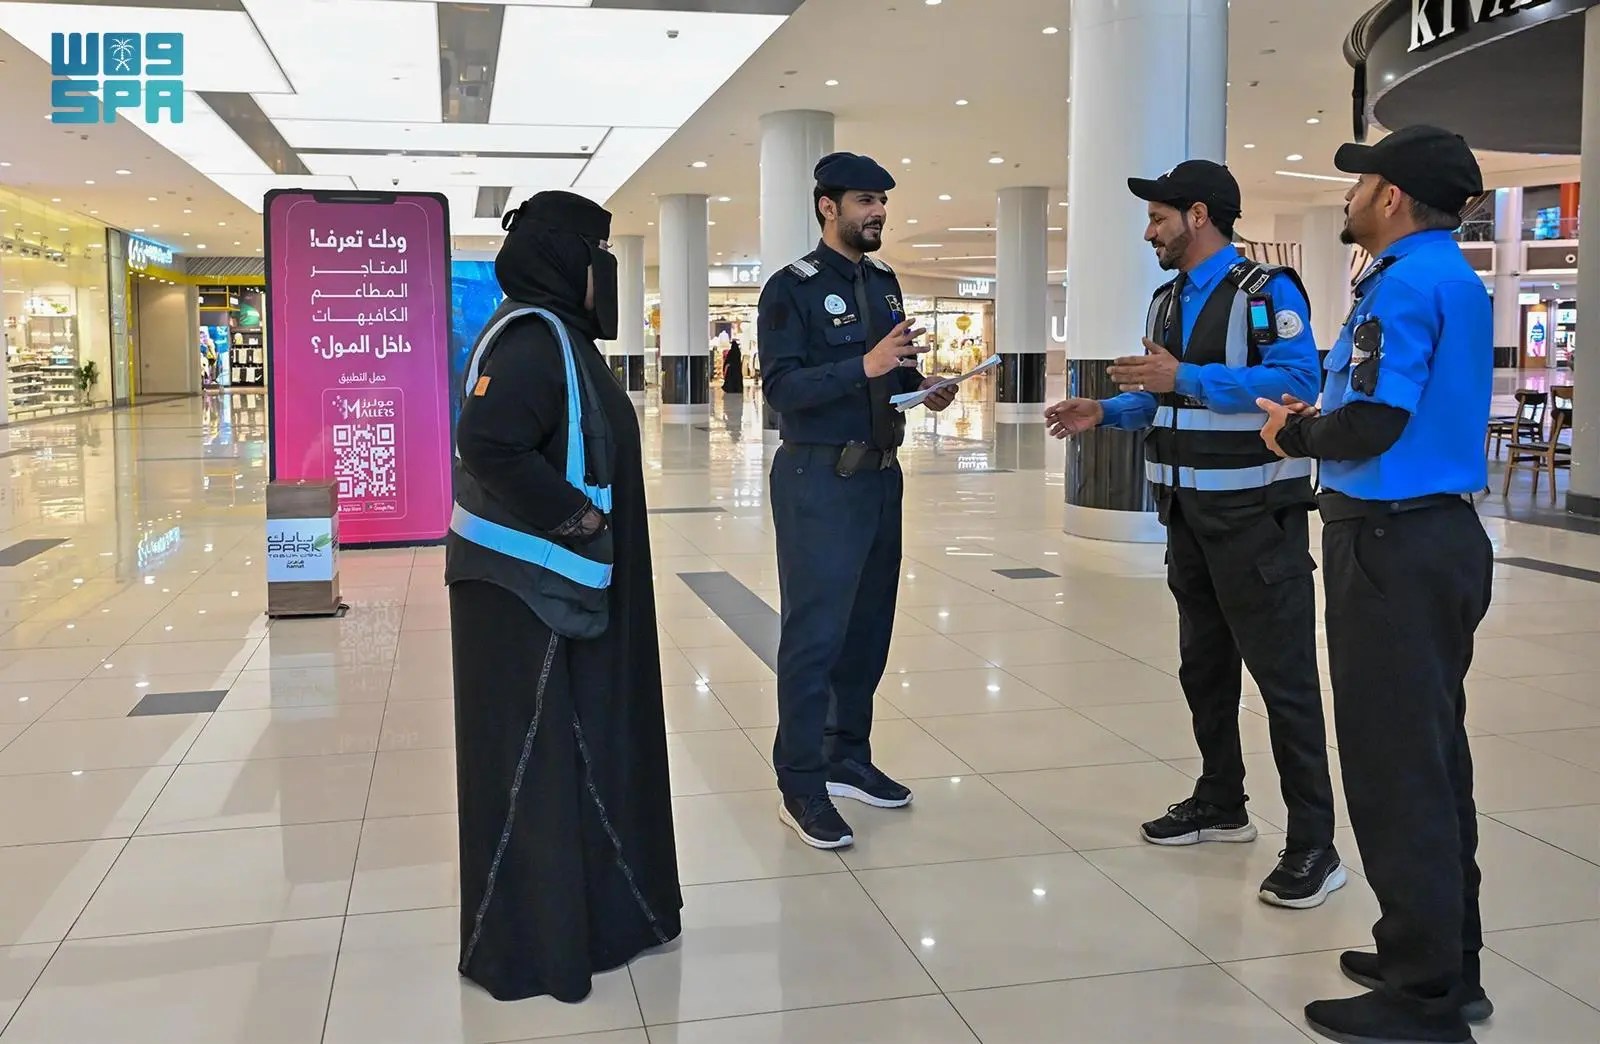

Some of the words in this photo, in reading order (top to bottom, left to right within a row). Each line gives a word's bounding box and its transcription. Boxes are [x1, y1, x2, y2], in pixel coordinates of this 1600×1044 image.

[309, 228, 363, 253] تعرف!
[368, 228, 407, 254] ودك
[310, 259, 408, 277] المتاجر
[311, 282, 408, 305] المطاعم
[312, 306, 408, 326] الكافيهات
[310, 334, 371, 360] المول؟
[375, 334, 412, 359] داخل
[338, 372, 368, 384] التطبيق
[368, 372, 387, 384] حمل
[267, 543, 321, 553] PARK
